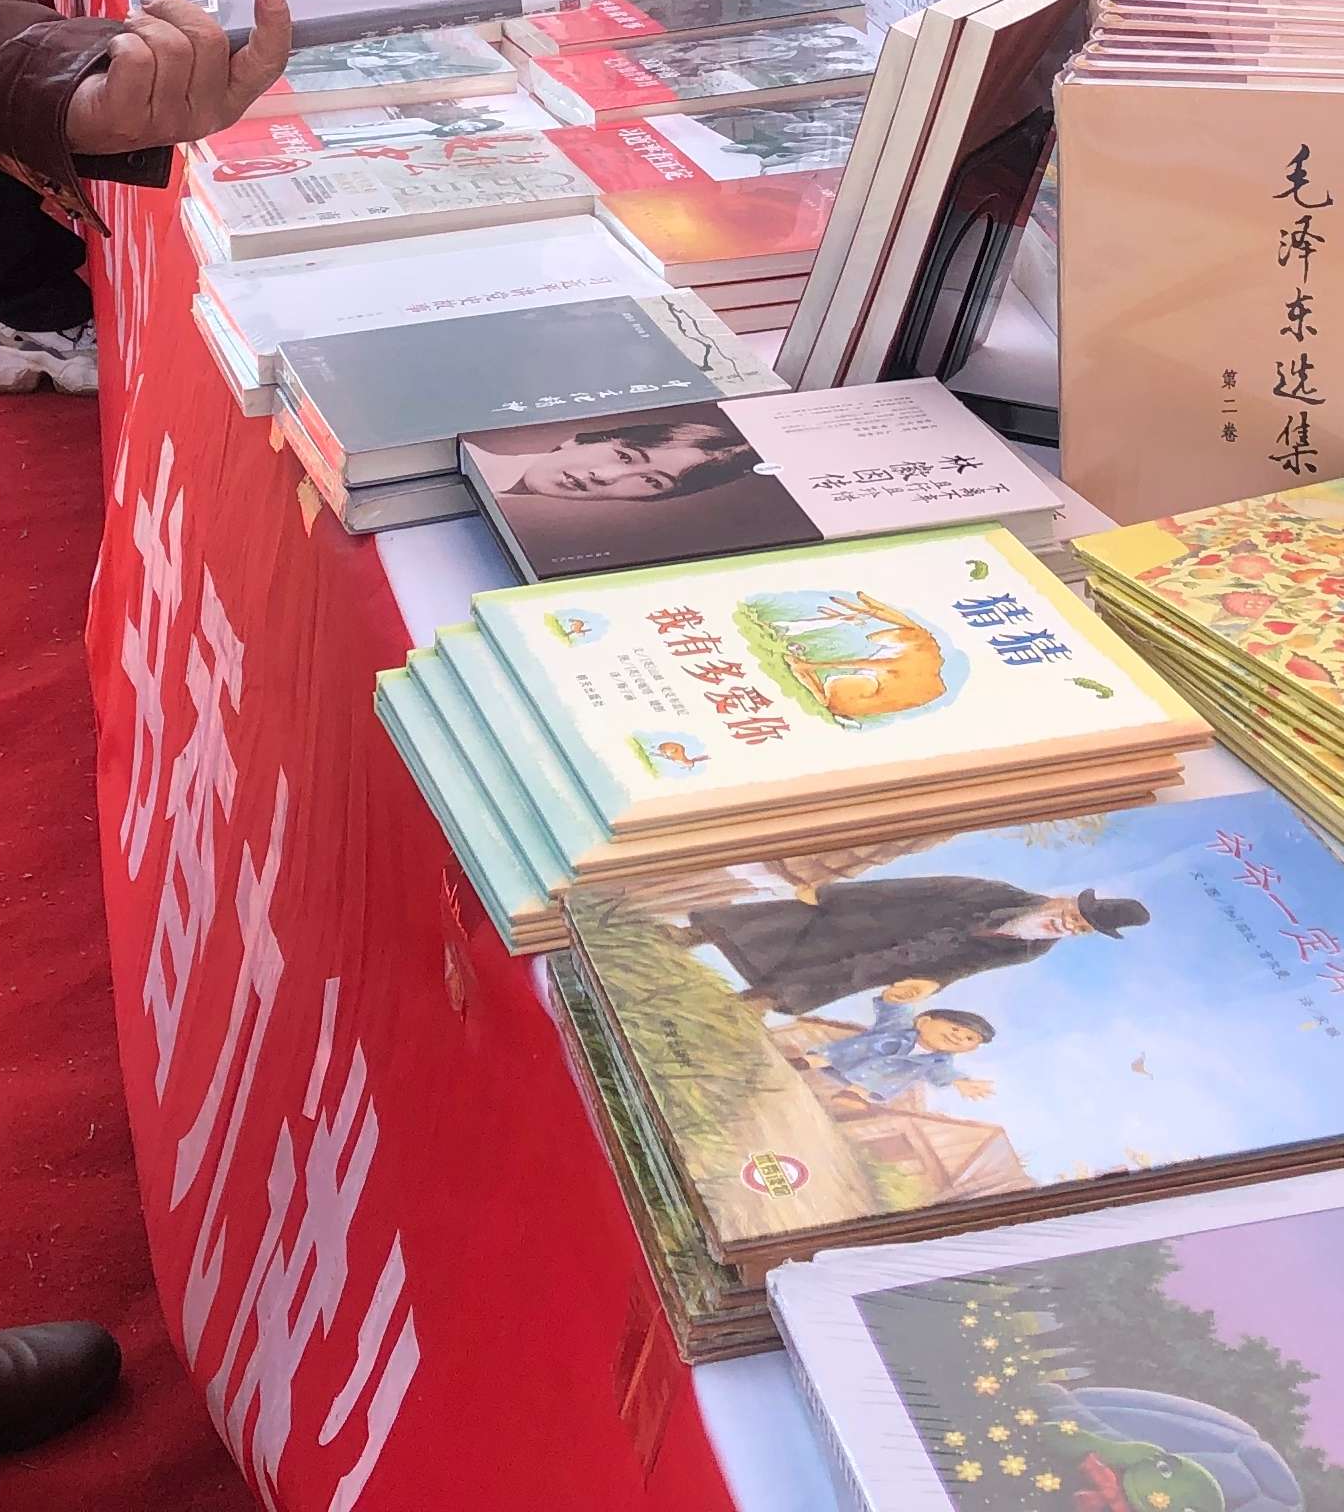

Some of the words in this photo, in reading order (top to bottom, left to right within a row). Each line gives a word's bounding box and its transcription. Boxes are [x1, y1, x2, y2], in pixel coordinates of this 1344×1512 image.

[616, 126, 696, 182] 习近平在正定
[1267, 142, 1334, 476] 毛泽东选集
[1220, 368, 1239, 444] 第二卷
[808, 455, 984, 491] 林徽因传
[951, 592, 1074, 670] 猜猜
[645, 606, 791, 745] 我有多爱你
